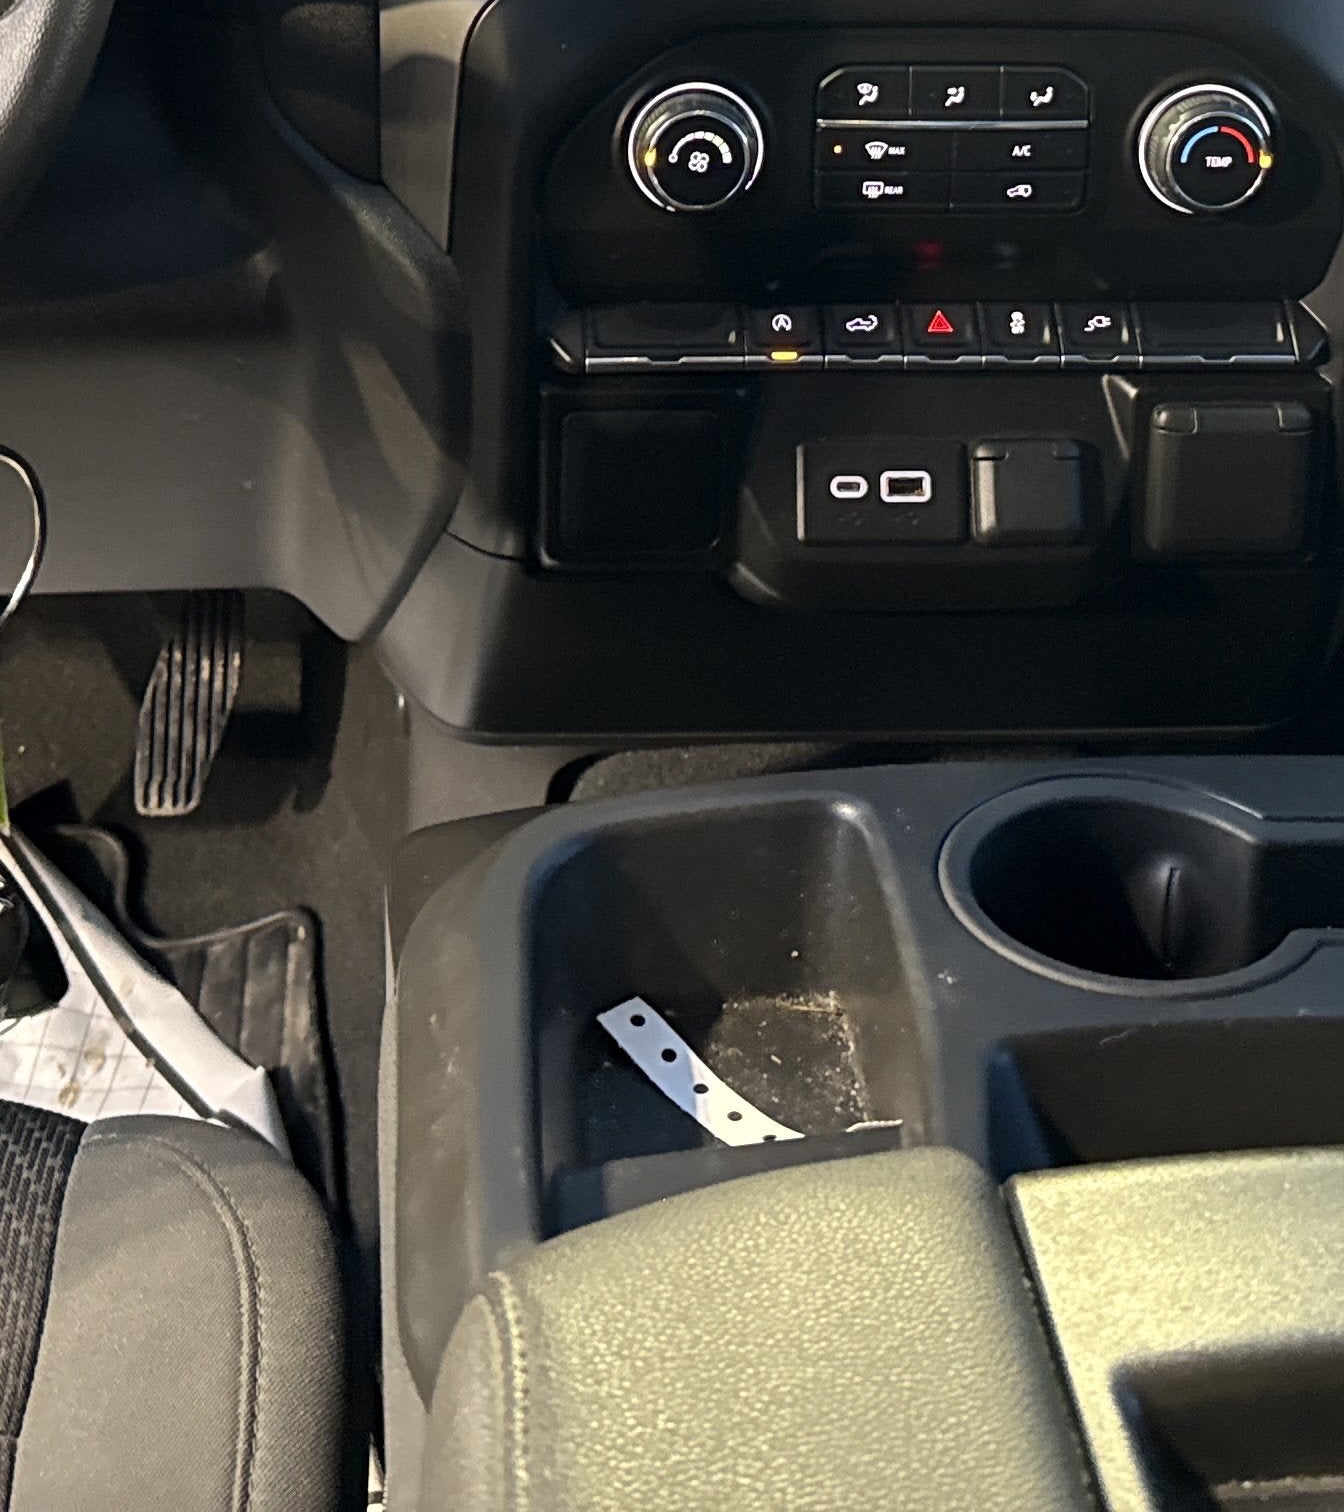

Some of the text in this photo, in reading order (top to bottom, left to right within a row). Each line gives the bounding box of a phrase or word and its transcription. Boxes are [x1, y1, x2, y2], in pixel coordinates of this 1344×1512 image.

[1011, 144, 1032, 157] A/C
[1204, 155, 1234, 168] TEMP
[883, 185, 904, 196] REAR
